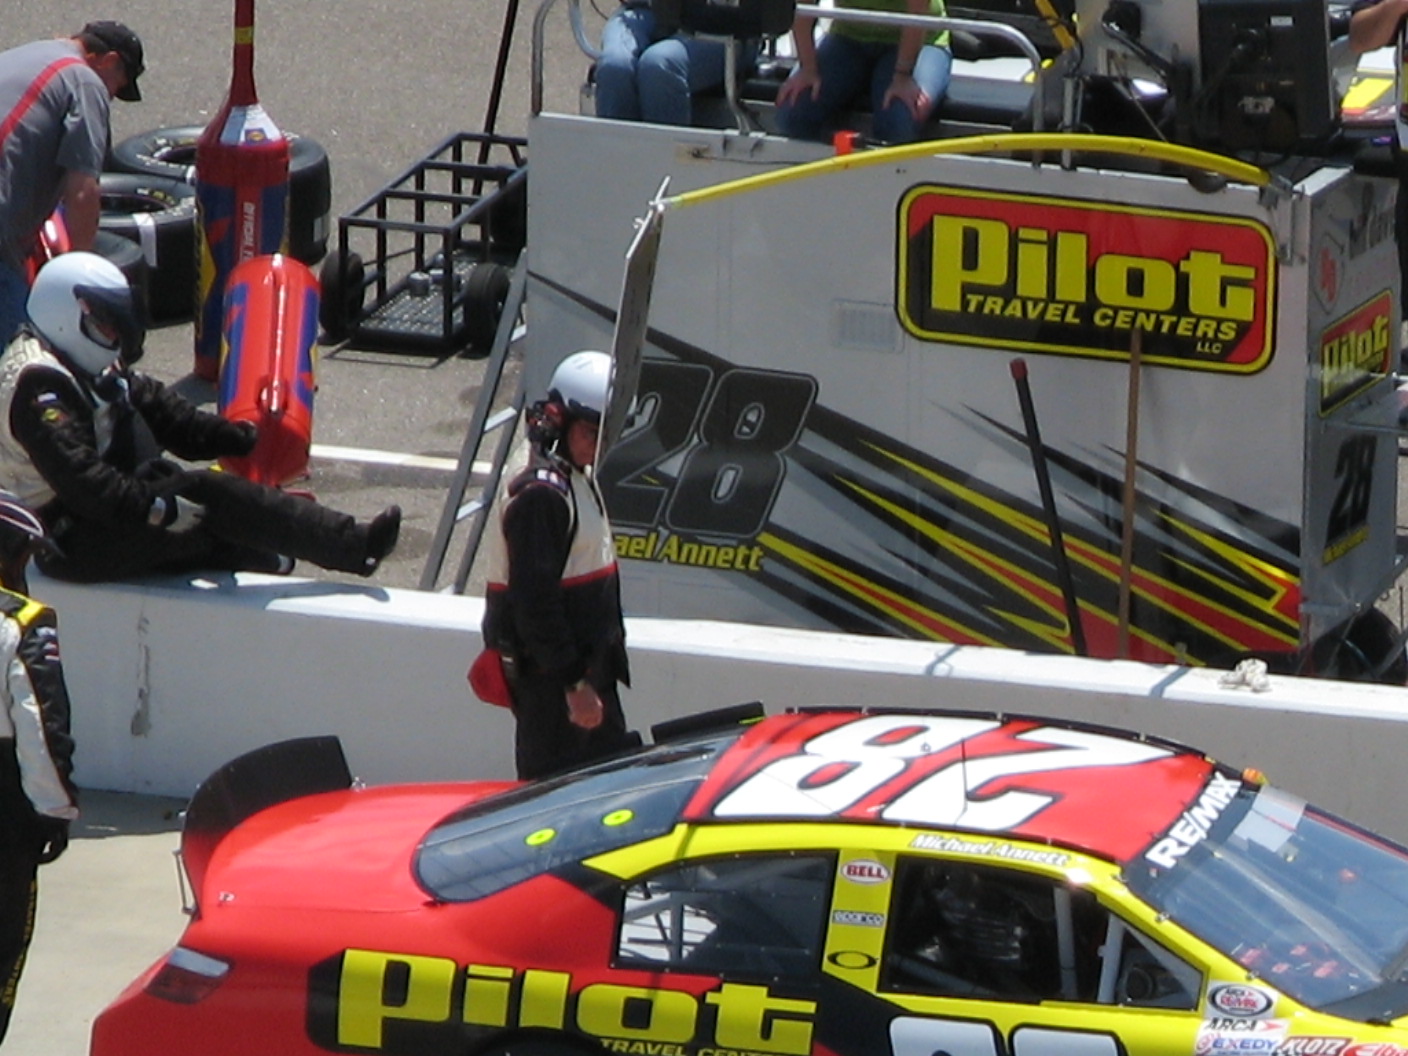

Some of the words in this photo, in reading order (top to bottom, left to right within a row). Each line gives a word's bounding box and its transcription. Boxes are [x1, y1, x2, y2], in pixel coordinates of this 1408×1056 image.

[931, 214, 1255, 322] Pilot
[966, 294, 1081, 324] TRAVEL
[1093, 308, 1238, 340] CENTERS
[1196, 341, 1222, 354] LLC
[1323, 314, 1389, 397] Pilot
[597, 358, 820, 538] 28
[1325, 435, 1377, 543] 28
[660, 534, 764, 571] Annett
[713, 714, 1177, 830] 28
[1145, 771, 1241, 869] RE/MAX
[846, 864, 885, 879] BELL
[911, 834, 993, 857] Michael
[996, 844, 1068, 866] Annett
[338, 949, 817, 1056] Pilot
[1206, 1018, 1257, 1032] ARCA
[1213, 1038, 1277, 1050] EXEDY
[1281, 1038, 1344, 1056] KLOTZ
